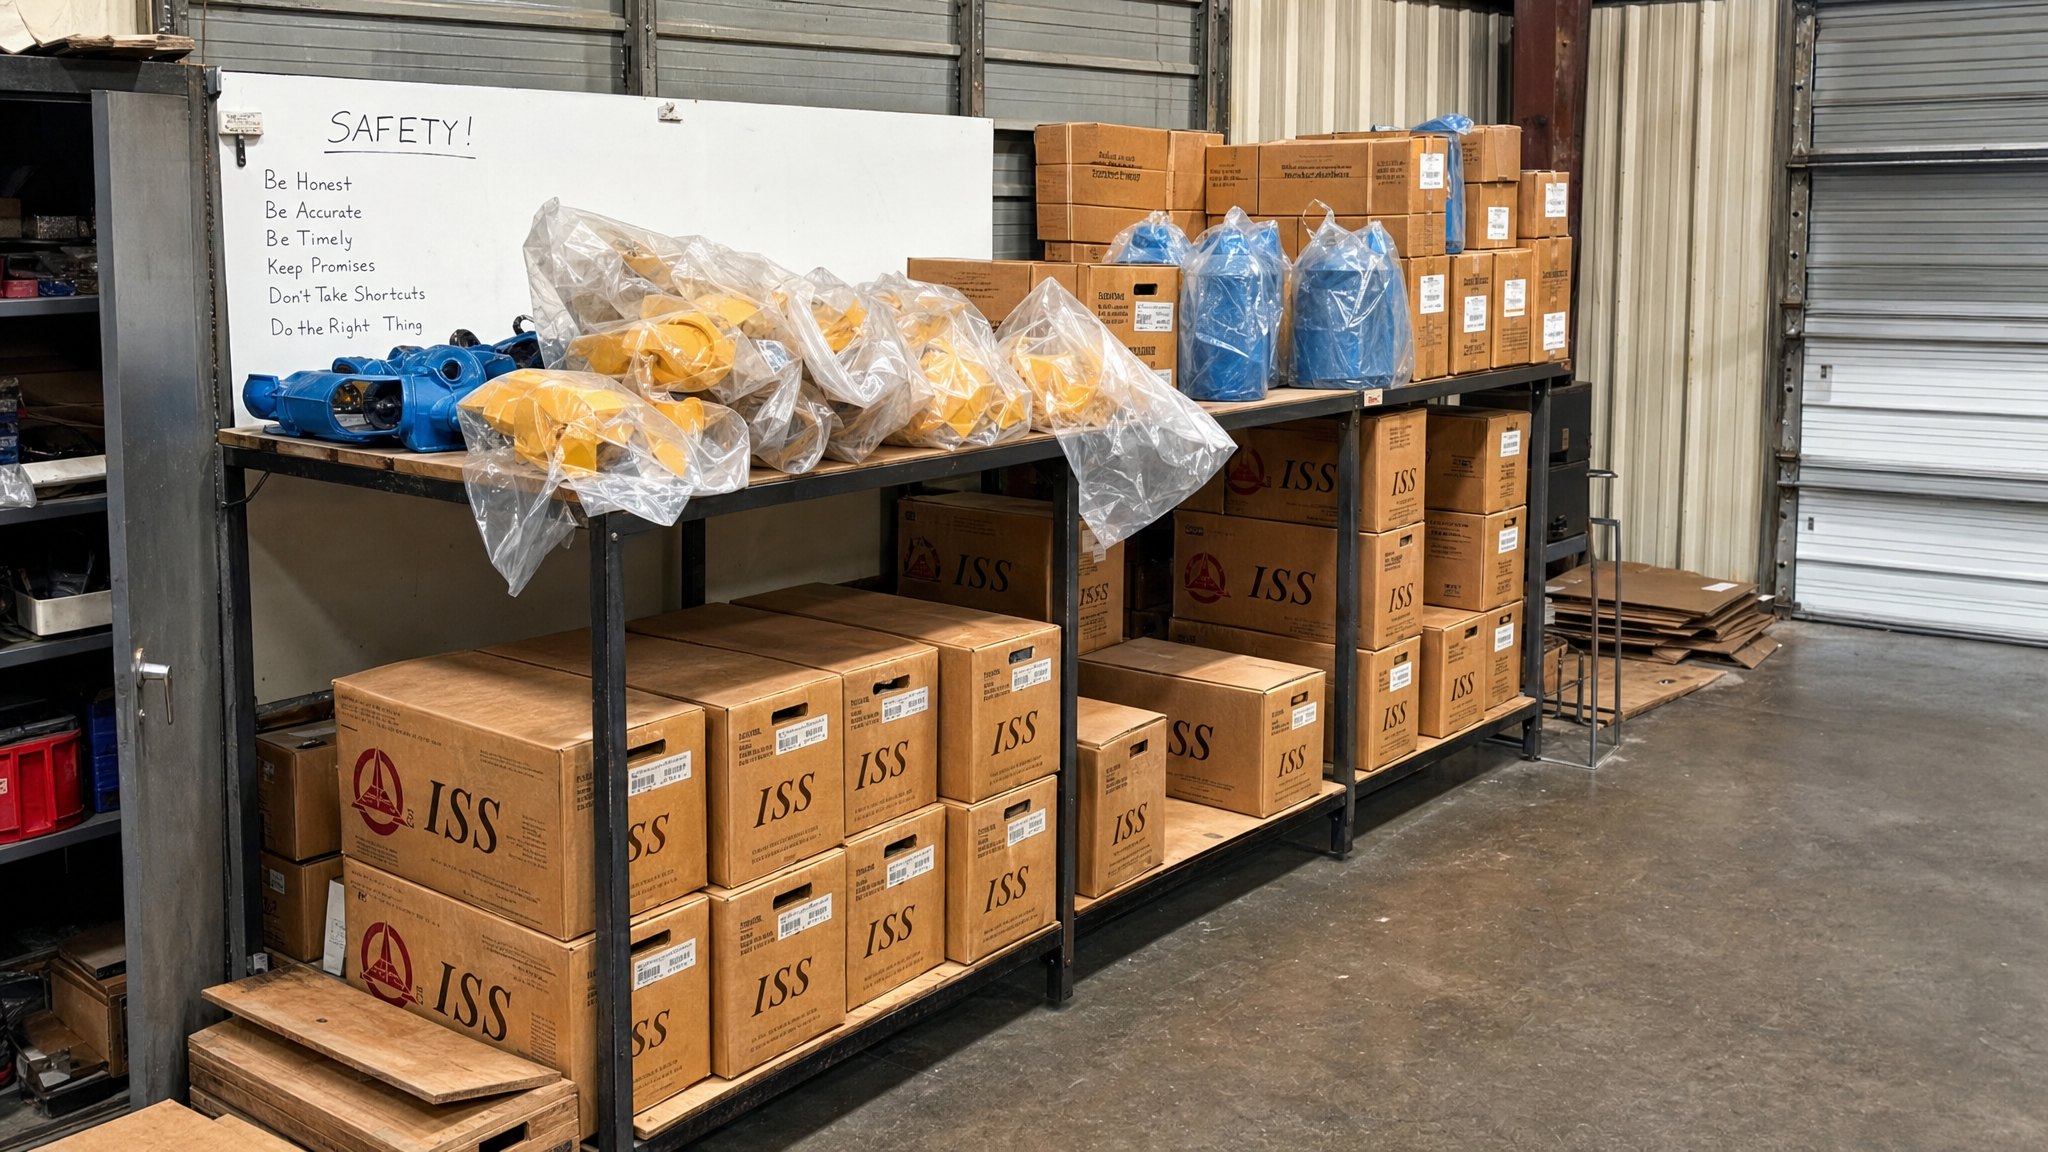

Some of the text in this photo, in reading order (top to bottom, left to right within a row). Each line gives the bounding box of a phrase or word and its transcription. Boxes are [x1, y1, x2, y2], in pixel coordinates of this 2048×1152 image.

[265, 169, 352, 191] Be Honest
[266, 201, 361, 218] Be Accurate
[267, 230, 352, 251] Be Timely
[268, 257, 375, 279] Keep Promises
[270, 286, 425, 304] Don't Take Shortcuts
[272, 316, 421, 339] Do the Right Thing
[1392, 468, 1416, 496] ISS
[953, 554, 1013, 593] ISS
[1248, 566, 1316, 605] ISS
[1388, 582, 1413, 613] ISS
[1451, 672, 1474, 701] ISS
[991, 711, 1038, 756] ISS
[1383, 701, 1407, 732] ISS
[1168, 720, 1213, 760] SS
[855, 740, 908, 791] ISS
[1277, 745, 1306, 778] ISS
[424, 780, 500, 854] ISS
[753, 772, 814, 828] ISS
[628, 812, 670, 862] SS
[1112, 802, 1147, 846] ISS
[984, 866, 1029, 913] ISS
[864, 905, 915, 959] ISS
[432, 961, 512, 1042] ISS
[752, 957, 812, 1017] ISS
[632, 1008, 671, 1058] SS
